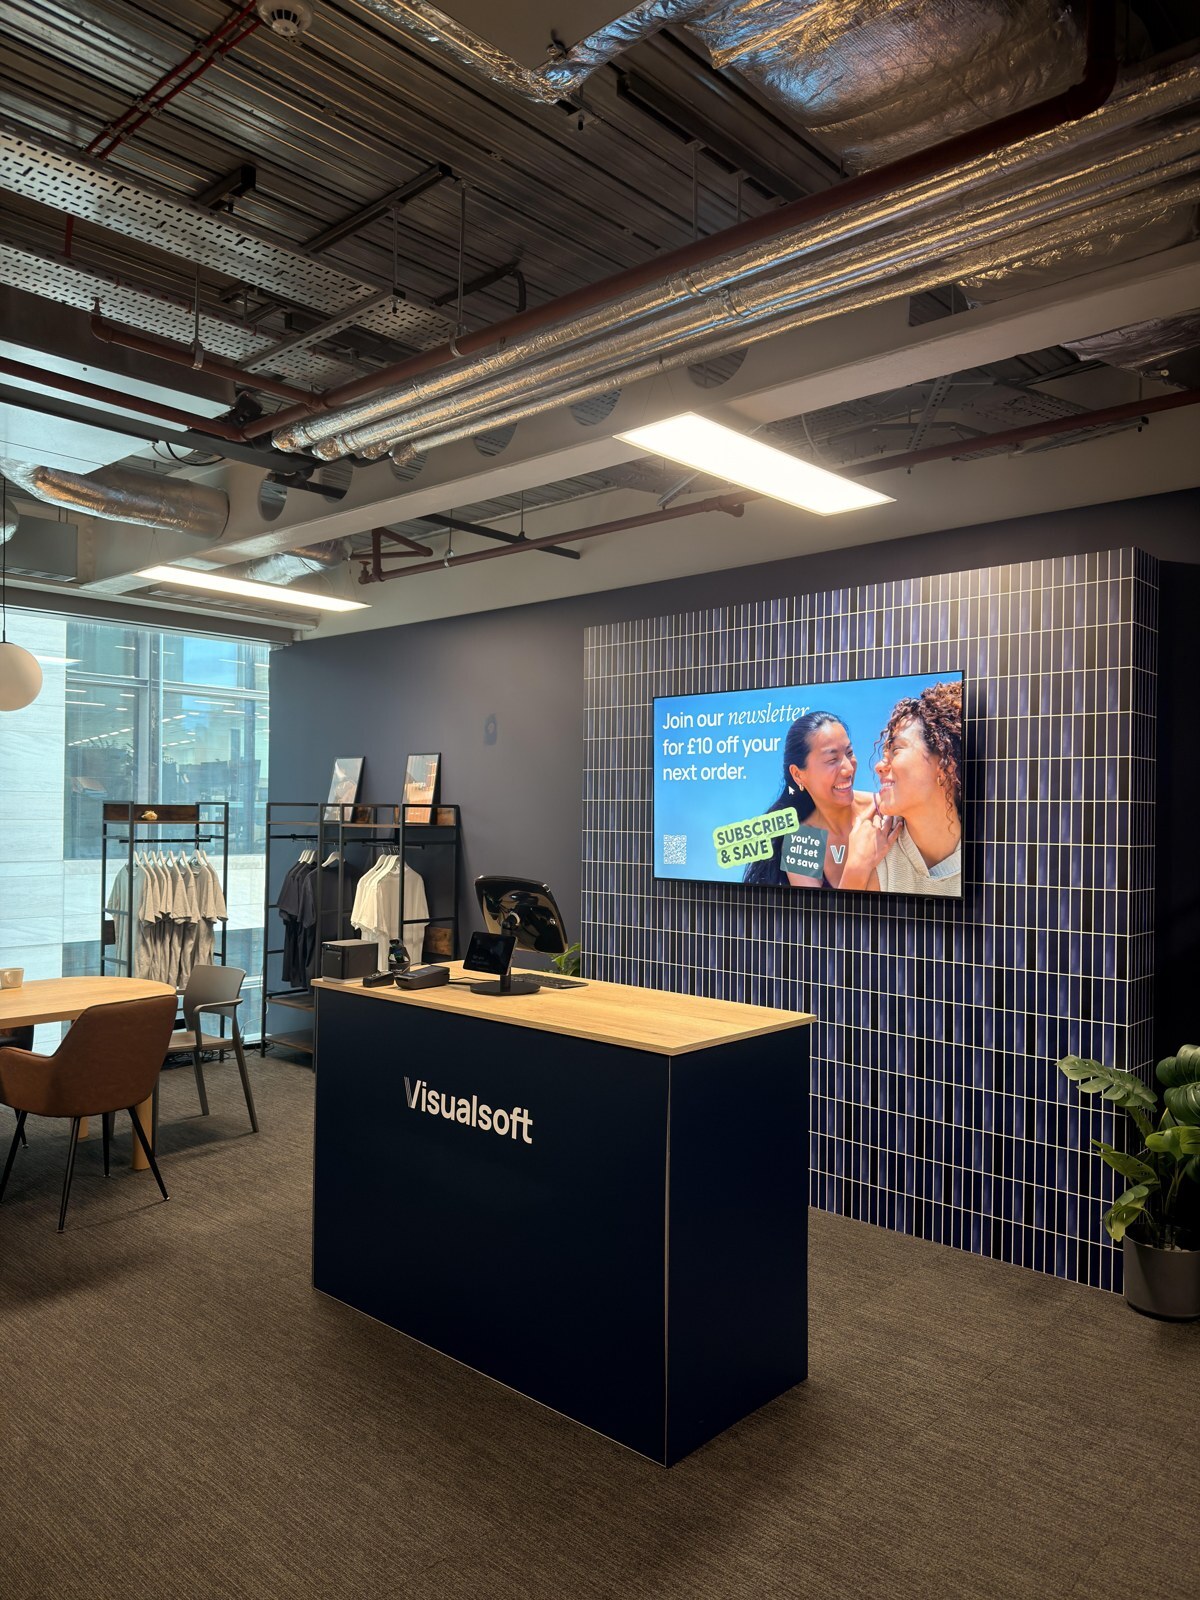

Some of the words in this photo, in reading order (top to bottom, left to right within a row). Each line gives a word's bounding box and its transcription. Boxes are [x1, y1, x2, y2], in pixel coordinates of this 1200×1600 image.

[662, 712, 694, 730] Join
[697, 713, 724, 727] our
[728, 702, 811, 726] newsletter
[662, 739, 684, 756] for
[687, 736, 713, 755] £10
[716, 735, 740, 754] off
[742, 737, 781, 758] your
[662, 764, 698, 781] next
[701, 763, 747, 781] order.
[717, 812, 795, 846] SUBSCRIBE
[721, 849, 731, 864] &
[733, 839, 769, 861] SAVE
[786, 855, 797, 865] to
[797, 858, 819, 870] save
[790, 845, 802, 855] all
[803, 848, 819, 858] set
[403, 1075, 534, 1145] Visualsoft
